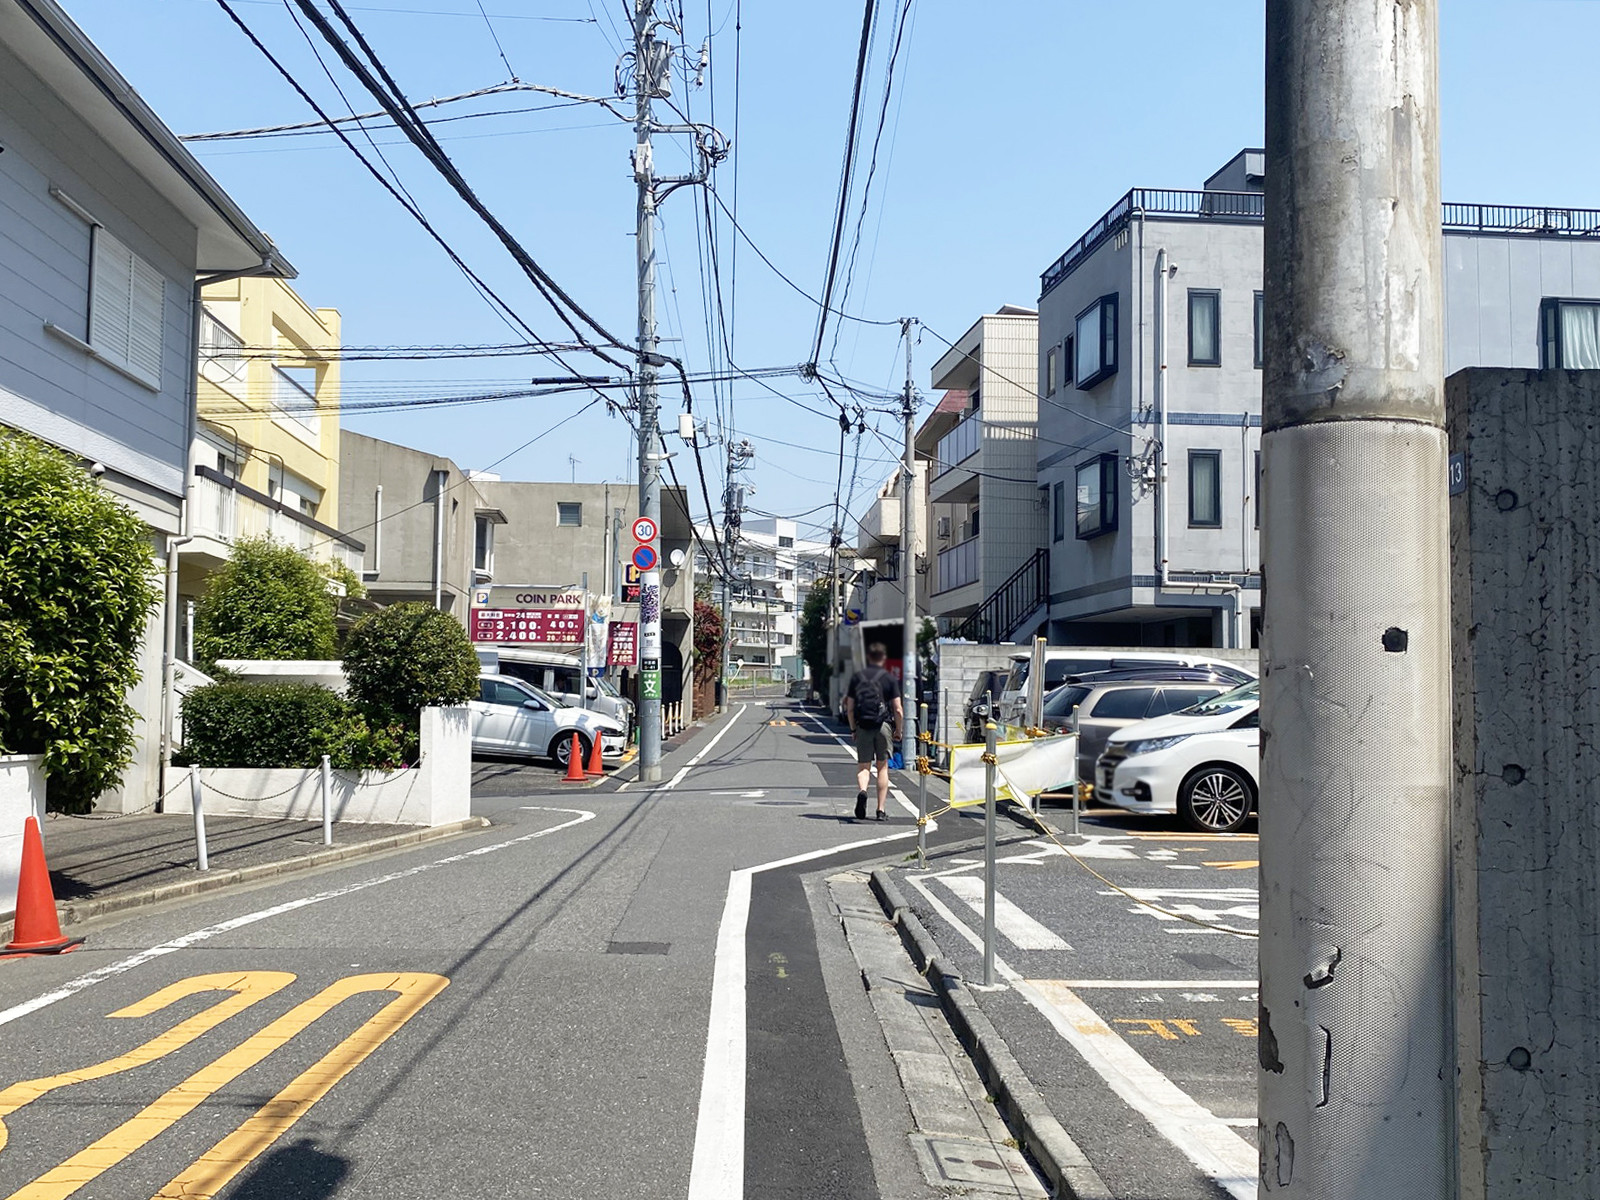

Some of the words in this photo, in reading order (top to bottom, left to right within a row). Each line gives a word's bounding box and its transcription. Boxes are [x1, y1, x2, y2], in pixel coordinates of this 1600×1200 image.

[1450, 462, 1462, 486] 13
[637, 524, 653, 537] 30
[515, 593, 547, 604] COIN
[549, 593, 581, 604] PARK
[644, 680, 656, 693] 文
